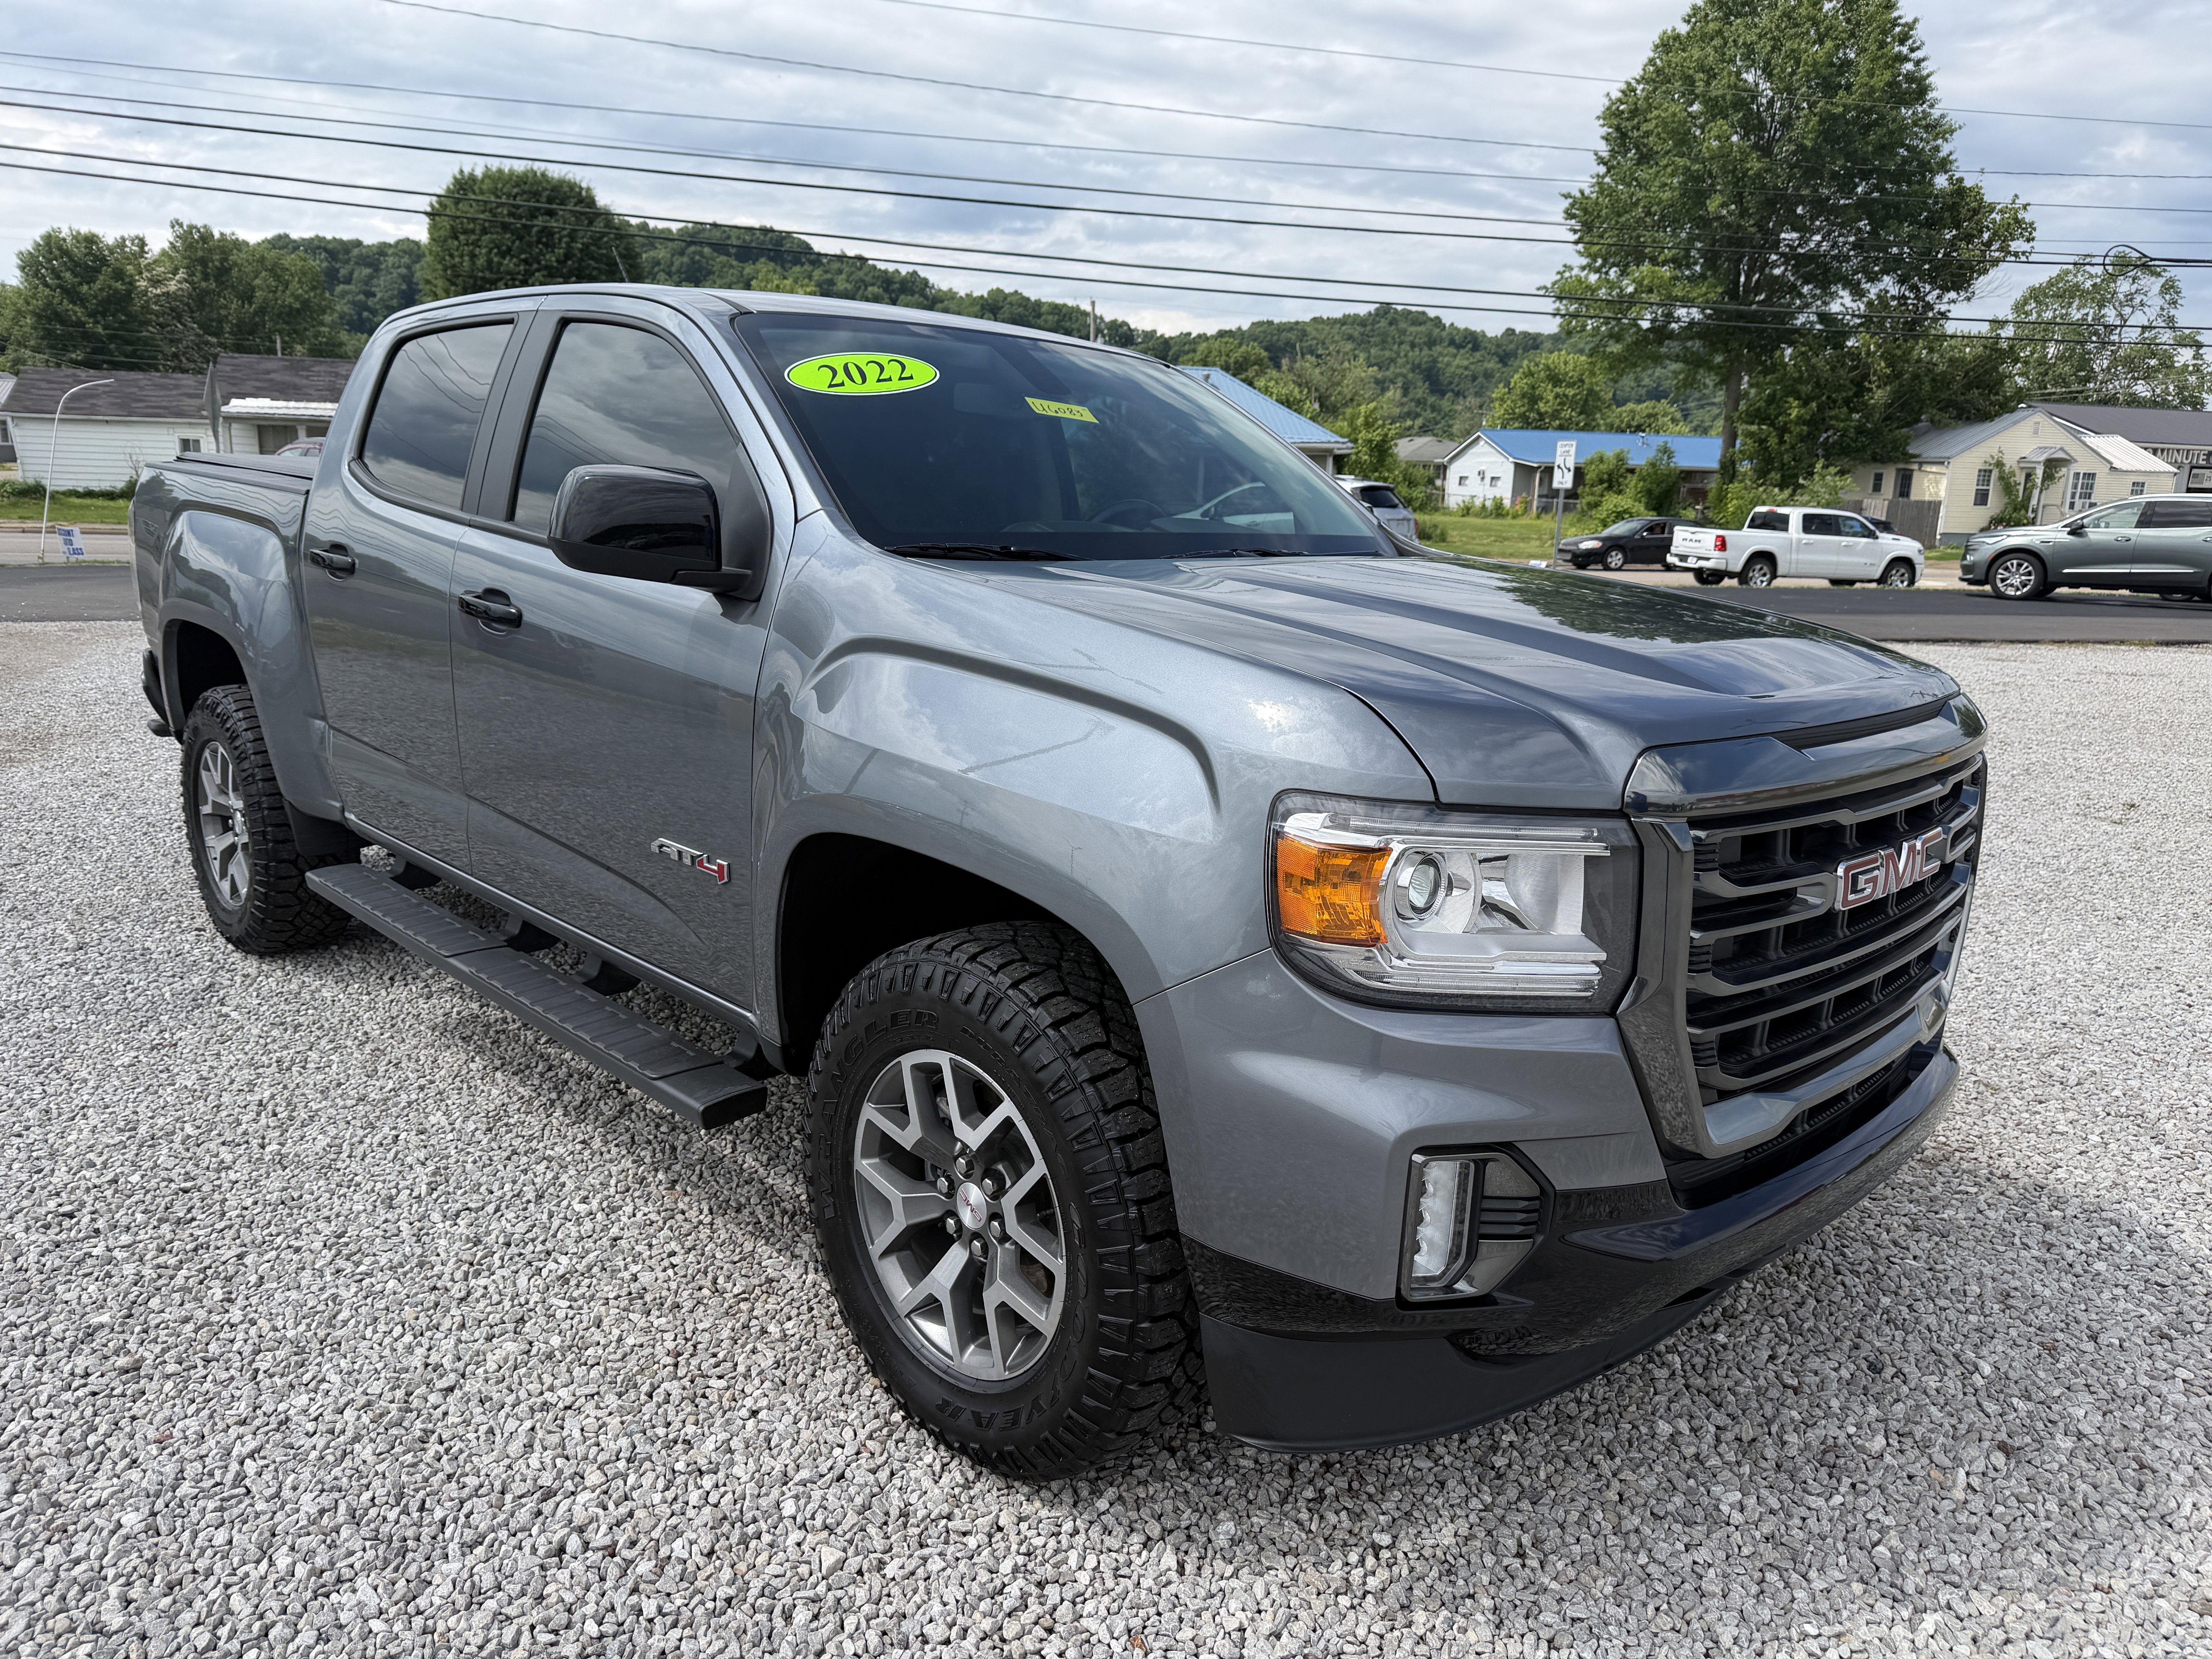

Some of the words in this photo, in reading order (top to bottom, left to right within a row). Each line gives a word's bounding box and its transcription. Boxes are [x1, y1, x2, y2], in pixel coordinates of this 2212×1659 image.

[817, 359, 914, 388] 2022
[2157, 448, 2207, 464] MINUTE
[651, 838, 731, 884] AT4
[1834, 826, 1943, 910] GMC
[819, 1008, 939, 1220] WRANGLER
[959, 1188, 983, 1222] GMC
[935, 1202, 1087, 1432] GOODYEAR
